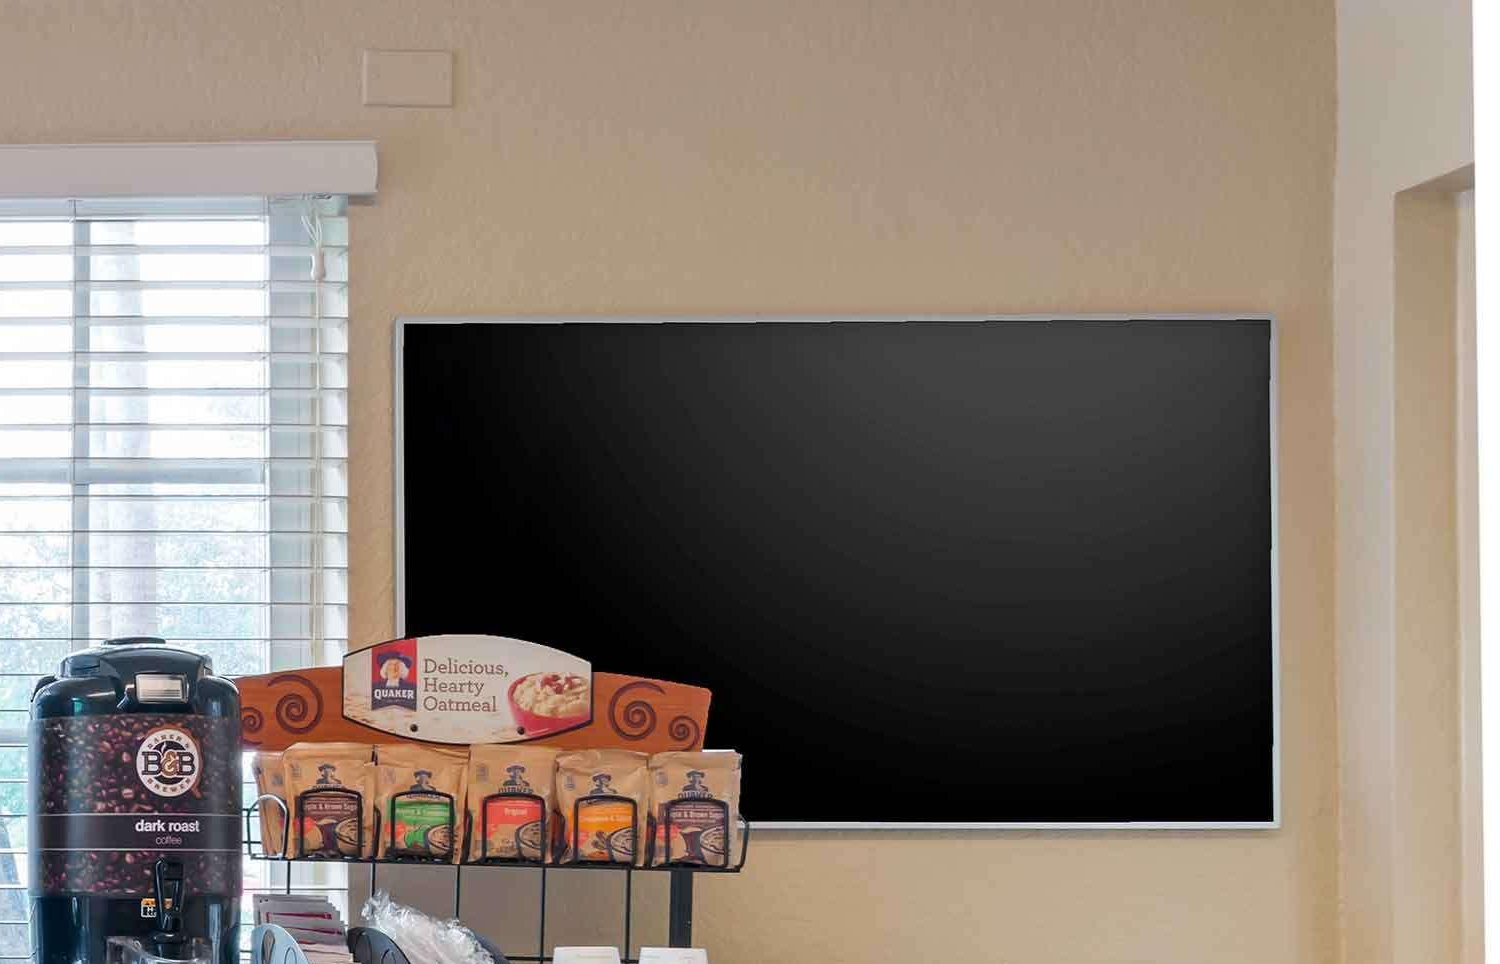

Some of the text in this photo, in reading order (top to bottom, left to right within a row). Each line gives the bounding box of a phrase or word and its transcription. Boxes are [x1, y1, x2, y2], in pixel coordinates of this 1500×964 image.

[423, 658, 509, 678] Delicious,
[374, 688, 414, 700] QUAKER
[423, 677, 485, 697] Hearty
[423, 695, 497, 713] Oatmeal
[141, 750, 195, 777] B&B
[135, 820, 200, 833] dark roast
[155, 836, 182, 845] coffee
